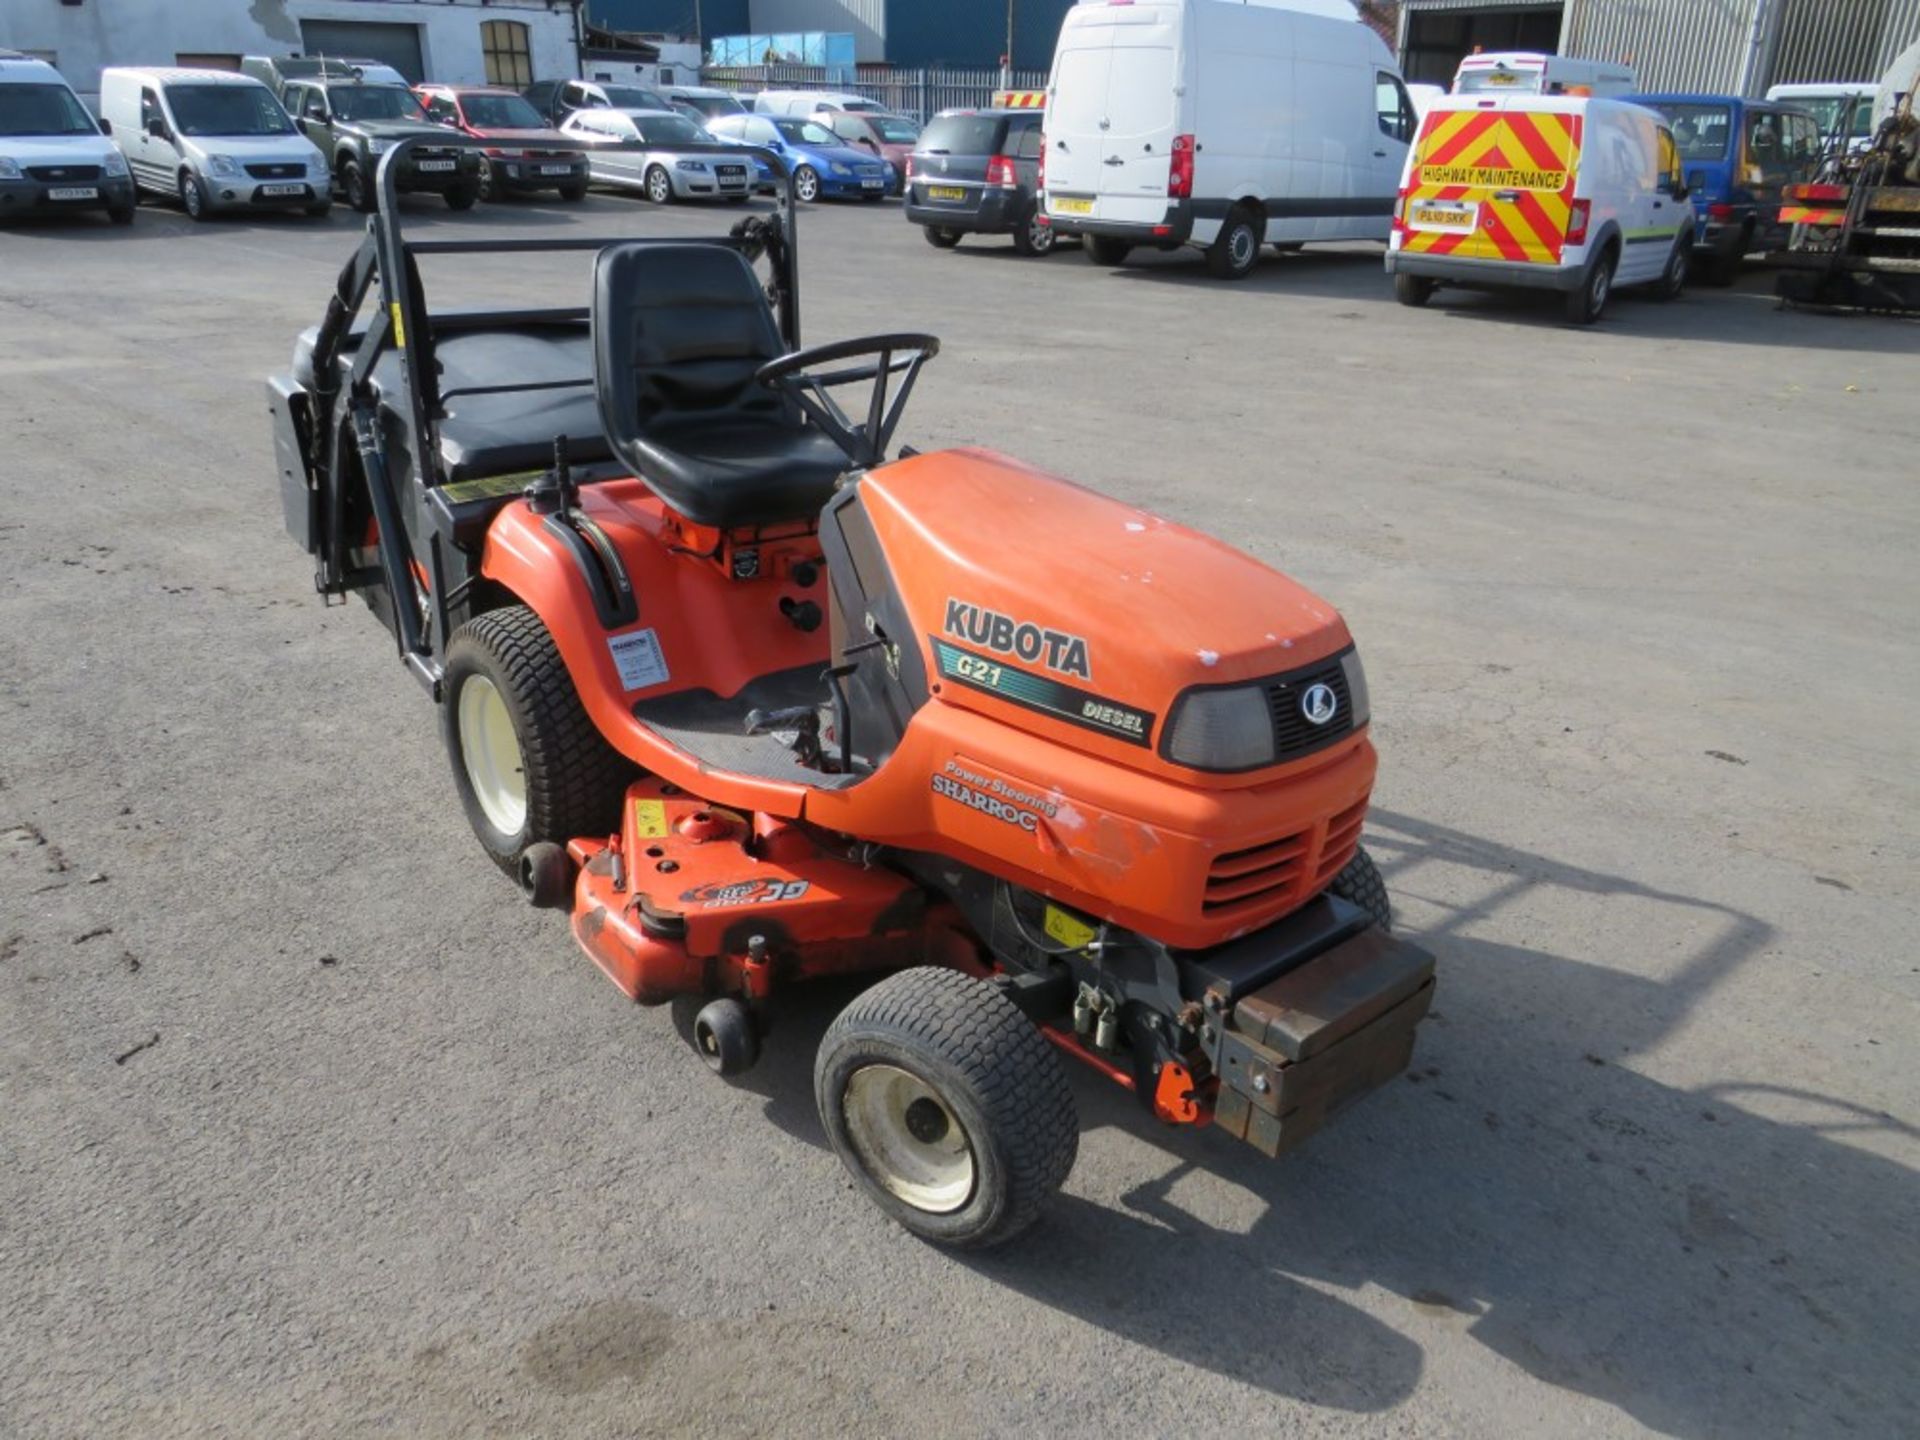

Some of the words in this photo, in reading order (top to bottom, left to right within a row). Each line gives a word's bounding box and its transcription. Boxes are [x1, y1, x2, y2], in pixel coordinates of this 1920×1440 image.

[1423, 167, 1474, 183] HIGHWAY
[1476, 169, 1562, 188] MAINTENANCE
[944, 597, 1091, 681] KUBOTA
[957, 655, 1002, 686] G21
[1082, 700, 1143, 733] DIESEL
[945, 761, 991, 788] Power
[991, 779, 1056, 818] Steering
